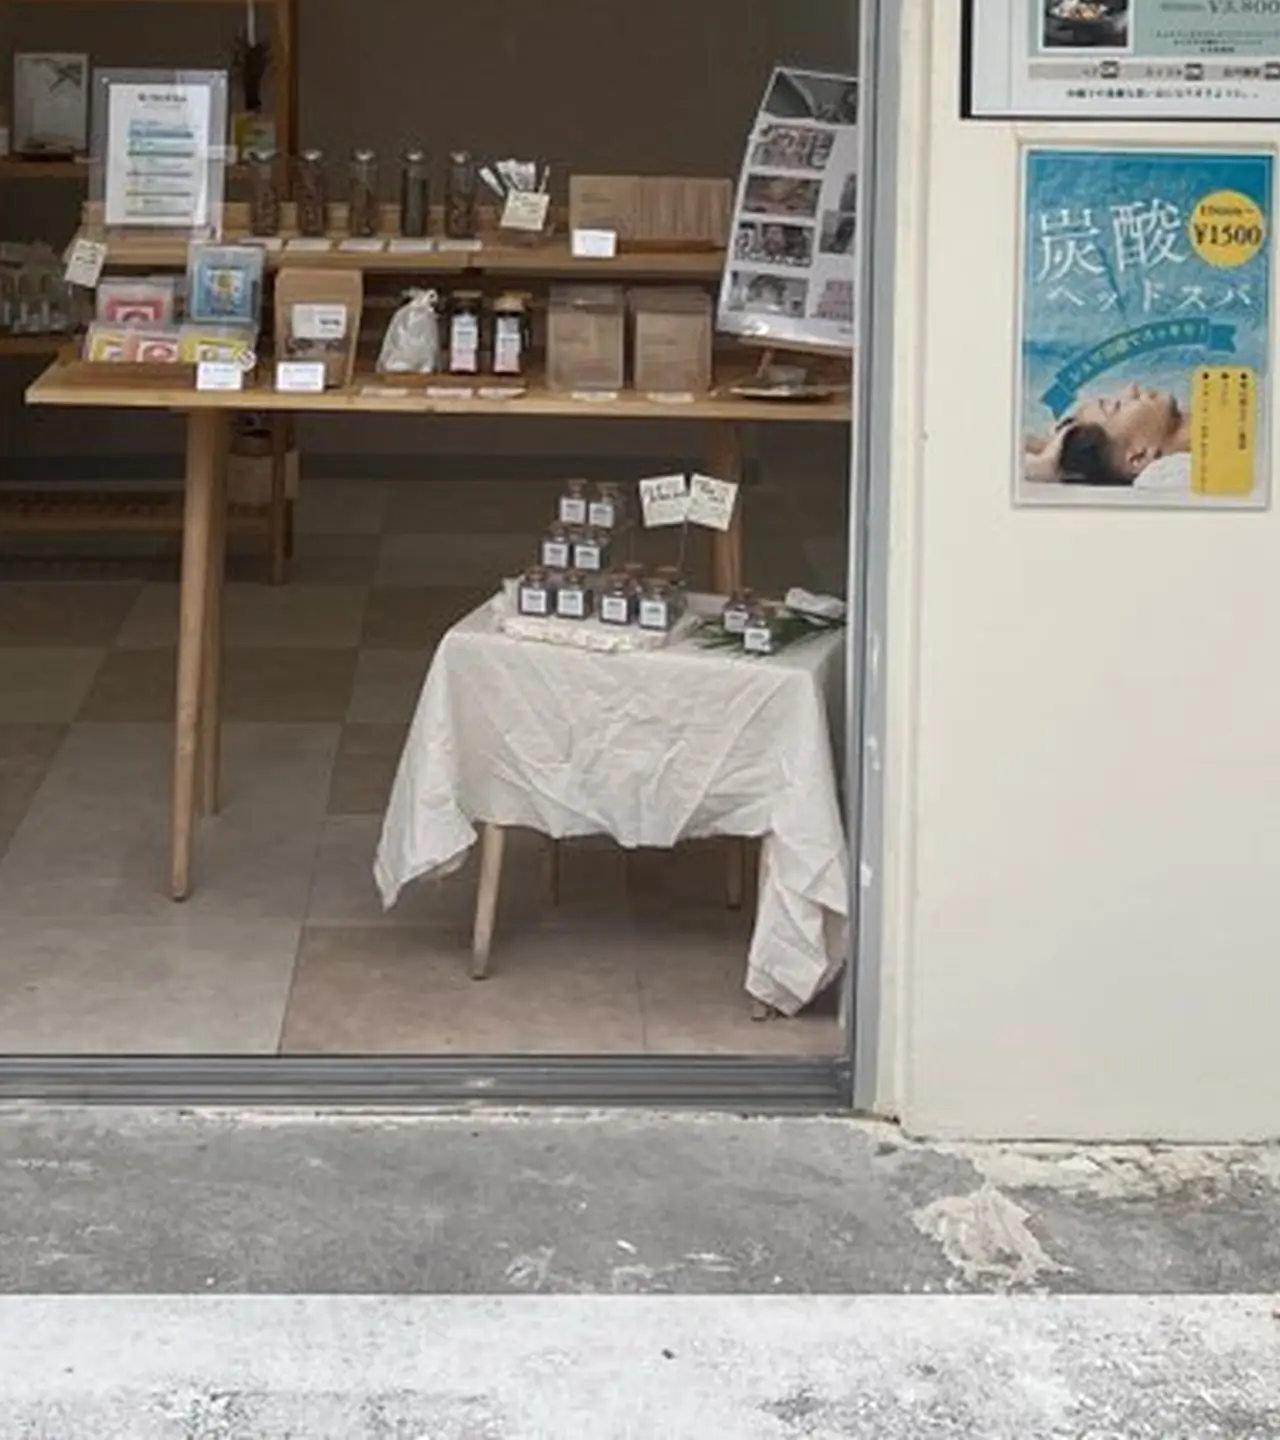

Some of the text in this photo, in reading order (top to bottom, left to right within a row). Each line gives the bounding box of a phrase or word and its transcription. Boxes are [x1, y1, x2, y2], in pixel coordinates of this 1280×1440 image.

[1037, 198, 1186, 283] 炭酸
[1193, 222, 1262, 247] ¥1500
[1046, 278, 1253, 312] ヘッドスパ
